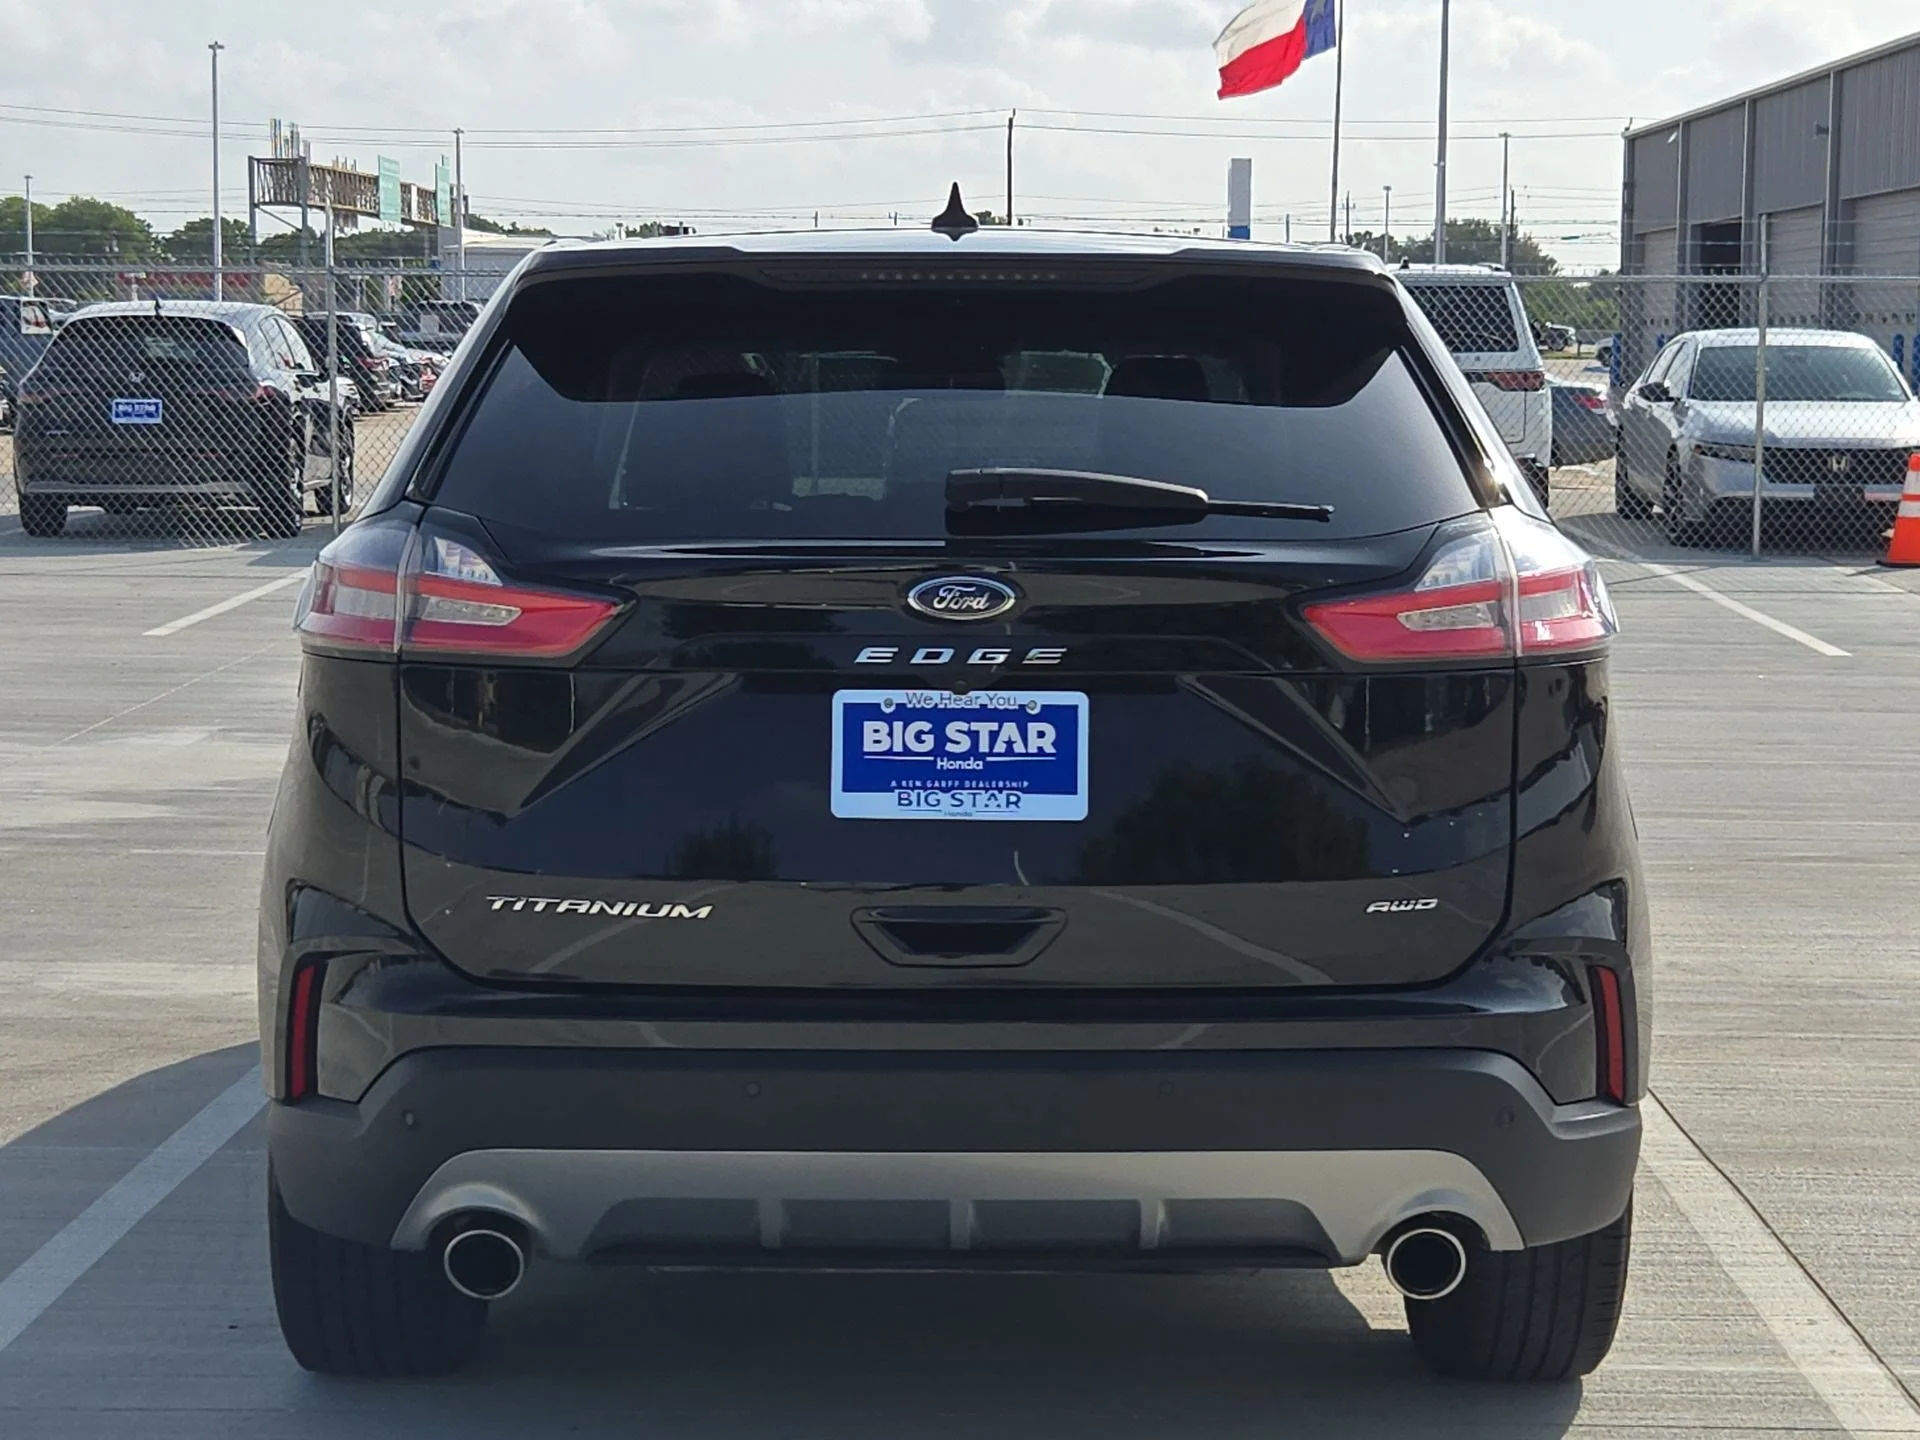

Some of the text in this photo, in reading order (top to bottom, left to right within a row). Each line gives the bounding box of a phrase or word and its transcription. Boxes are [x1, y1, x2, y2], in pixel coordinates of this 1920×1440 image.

[933, 585, 990, 610] Ford
[854, 646, 1068, 664] EDGE
[905, 692, 1017, 708] We Hear You
[863, 721, 1057, 753] BIG STAR
[936, 757, 984, 770] Honda
[926, 780, 960, 788] GARFF
[964, 780, 1029, 788] DEALERSHIP
[897, 791, 1021, 808] BIG STAR
[486, 895, 713, 919] TITANIUM
[1366, 898, 1438, 913] AWD
